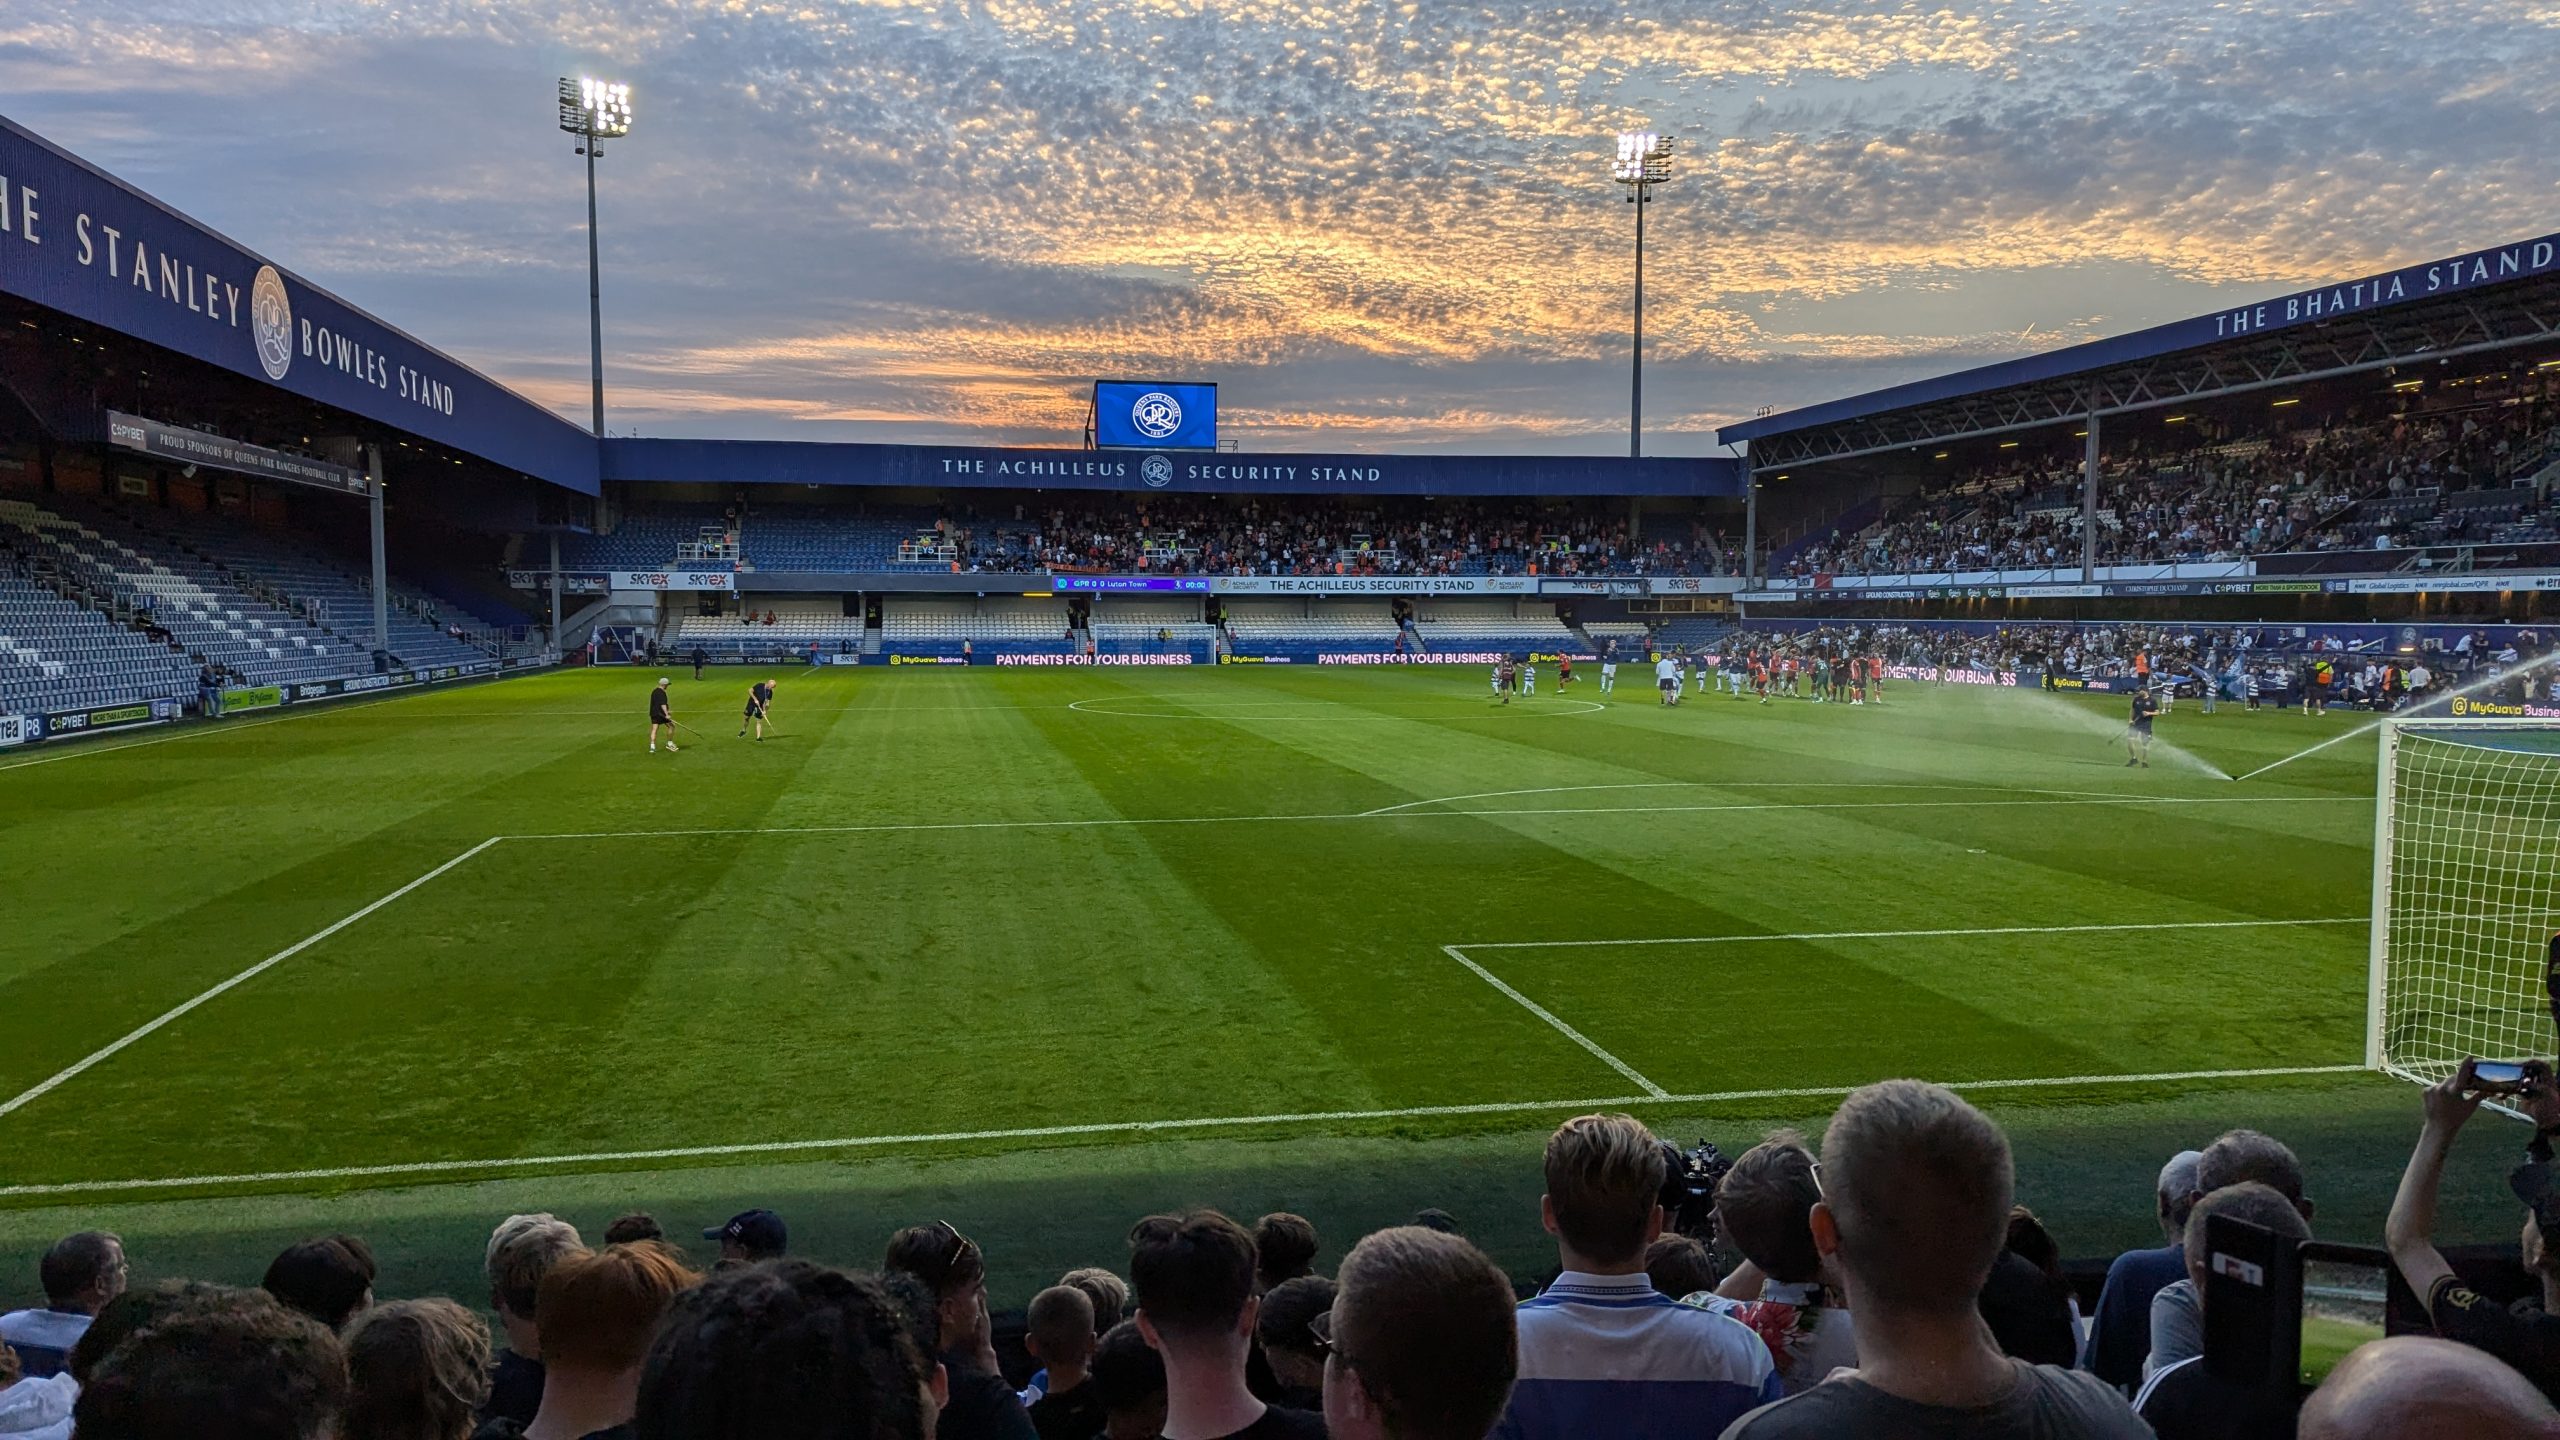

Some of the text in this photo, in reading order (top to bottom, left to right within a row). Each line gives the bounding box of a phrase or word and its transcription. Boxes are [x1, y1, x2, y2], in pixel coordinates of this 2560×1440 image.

[76, 213, 238, 327] STANLEY
[2216, 242, 2553, 336] THE BHATIA STAND
[302, 318, 453, 416] BOWLES STAND
[160, 433, 341, 484] PROUD SPONSORS OF QUEENS PARK RANGERS FOOTBALL CLUB
[942, 459, 984, 473] THE
[998, 460, 1125, 477] ACHILLEUS
[1188, 465, 1297, 480] SECURITY
[1311, 467, 1380, 482] STAND
[1185, 581, 1206, 589] 00:00
[1270, 580, 1475, 591] THE ACHILLEUS SECURITY STAND
[2387, 582, 2409, 590] Logistics
[1865, 591, 1883, 599] GROUND
[1883, 591, 1915, 599] CONSTRUCTION
[902, 656, 937, 664] MyGuava
[996, 654, 1192, 665] PAYMENTS FOR YOUR BUSINESS
[1232, 656, 1264, 664] MyGuava
[1318, 653, 1381, 665] PAYMENTS
[1409, 653, 1442, 664] YOUR
[1445, 652, 1502, 664] BUSINESS
[344, 678, 361, 692] GROUND
[361, 674, 389, 689] CONSTRUCTION
[1918, 668, 1937, 681] FOR
[1944, 669, 1965, 683] OUR
[2053, 677, 2083, 688] MyGuava
[2088, 679, 2110, 689] usiness
[300, 684, 327, 698] Bridgegate
[2470, 701, 2522, 716] MyGuava
[0, 720, 19, 739] rea
[26, 718, 40, 737] P8
